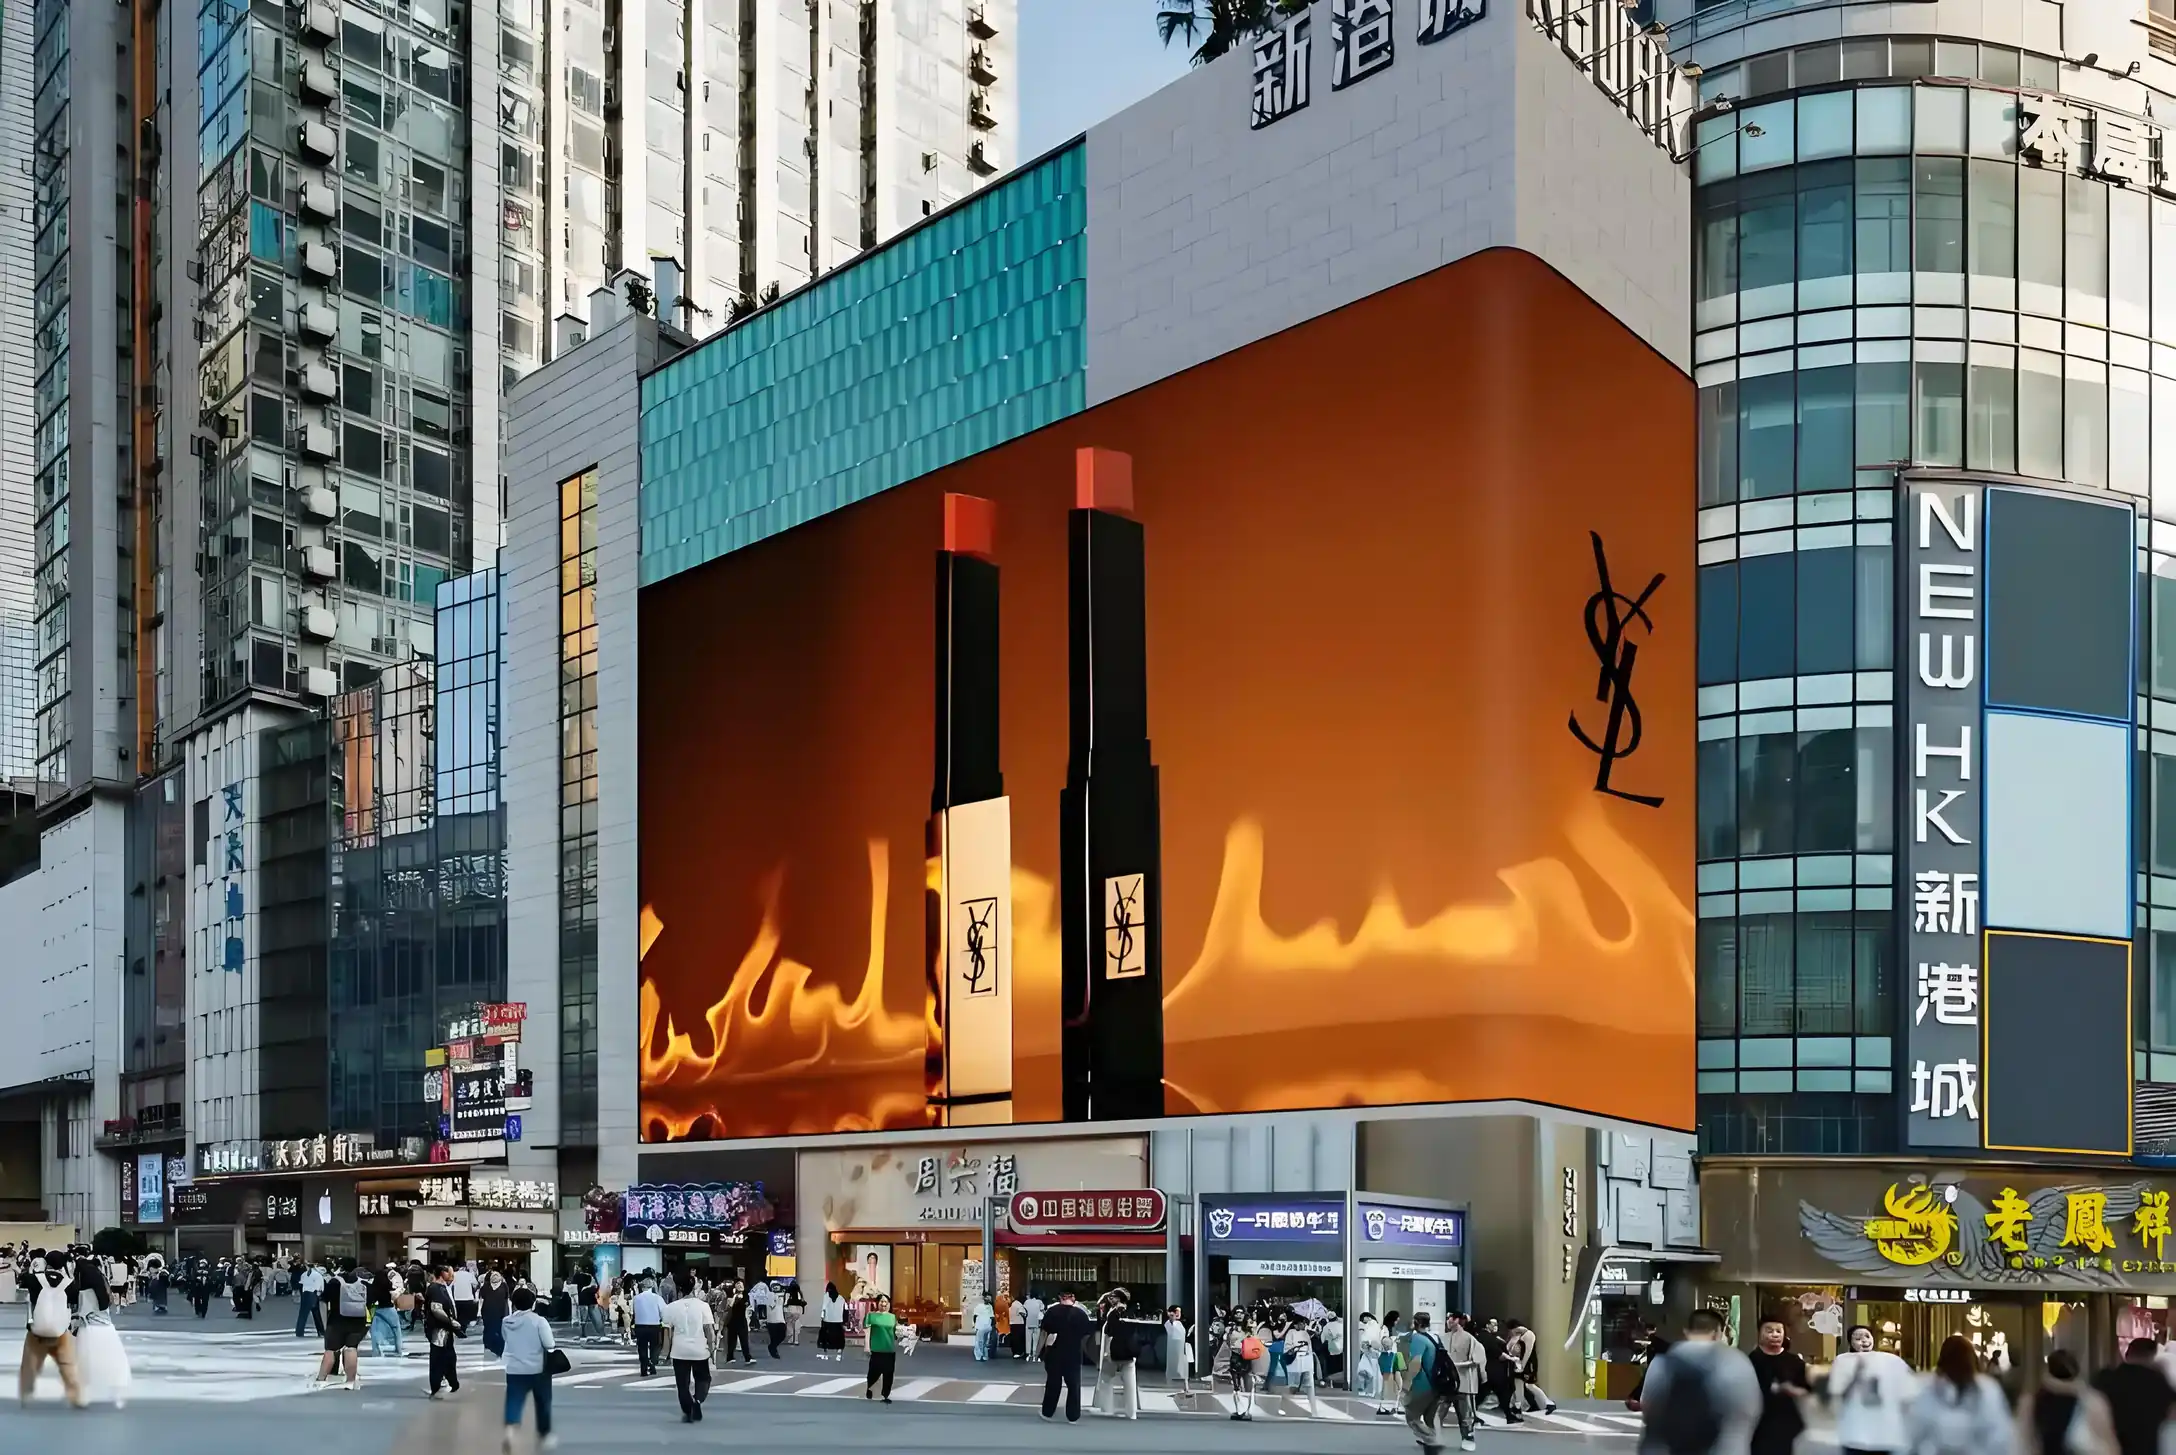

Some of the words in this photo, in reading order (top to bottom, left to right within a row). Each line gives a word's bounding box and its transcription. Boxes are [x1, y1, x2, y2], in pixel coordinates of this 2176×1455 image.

[1567, 530, 1667, 809] YSL
[1919, 491, 1975, 690] NEW
[1915, 723, 1972, 845] HK
[1910, 869, 1980, 1122] 新港城
